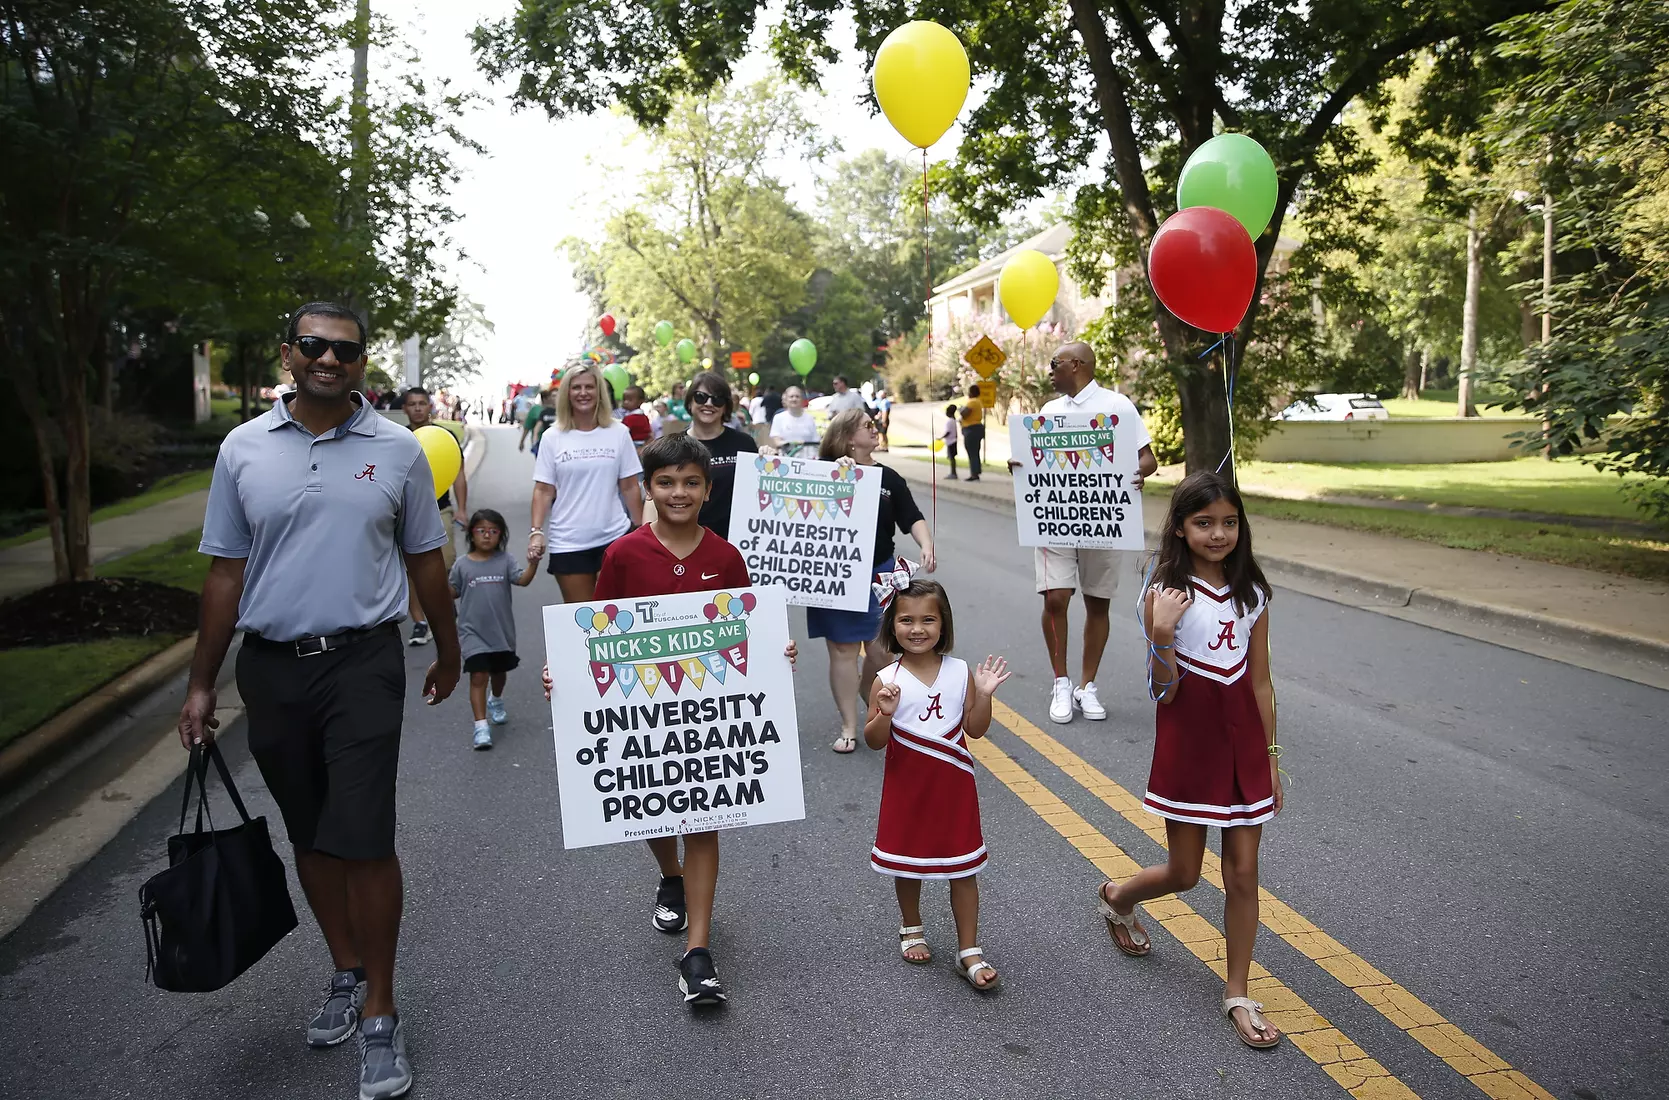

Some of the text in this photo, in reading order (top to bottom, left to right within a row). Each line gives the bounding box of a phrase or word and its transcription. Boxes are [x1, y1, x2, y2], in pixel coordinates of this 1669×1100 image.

[1033, 432, 1111, 447] NICK'S KIDS AVE
[1034, 445, 1113, 464] JUBILEE
[354, 463, 376, 482] A
[1028, 473, 1124, 488] UNIVERSITY
[762, 479, 851, 496] NICK'S KIDS AVE
[1024, 489, 1131, 505] of ALABAMA
[760, 493, 850, 513] JUBILEE
[1033, 506, 1125, 521] CHILDREN'S
[748, 518, 858, 544] UNIVERSITY
[1037, 522, 1123, 538] PROGRAM
[739, 536, 862, 562] of ALABAMA
[746, 554, 852, 579] CHILDREN'S
[750, 572, 846, 596] PROGRAM
[654, 614, 698, 623] TUSCALOOSA
[594, 624, 742, 661] NICK'S KIDS AVE
[1208, 619, 1237, 650] A
[596, 646, 746, 685] JUBILEE
[583, 691, 766, 735] UNIVERSITY
[918, 692, 944, 721] A
[576, 720, 780, 765] of ALABAMA
[593, 750, 769, 793] CHILDREN'S
[602, 778, 765, 822] PROGRAM
[693, 811, 747, 823] NICK'S KIDS
[624, 824, 675, 838] Presented by
